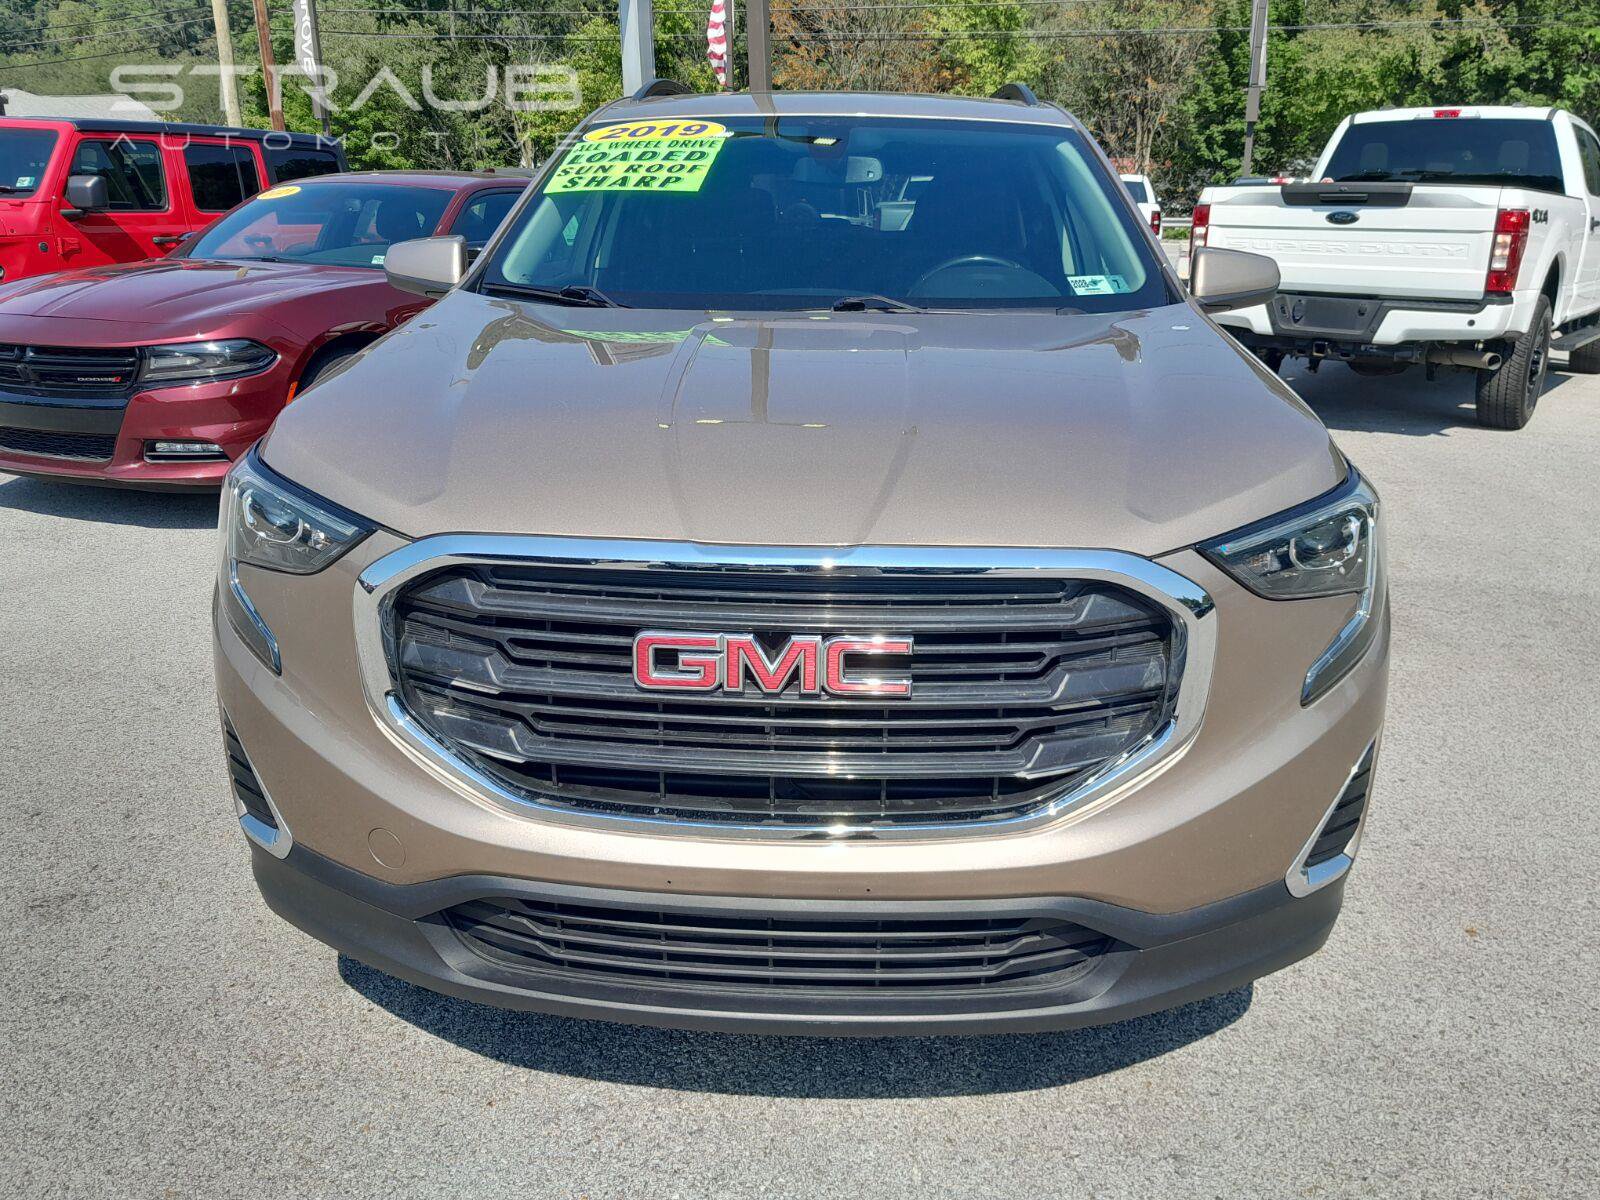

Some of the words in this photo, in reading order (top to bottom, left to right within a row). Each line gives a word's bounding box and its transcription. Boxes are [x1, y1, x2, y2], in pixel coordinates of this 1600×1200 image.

[600, 123, 709, 140] 2019
[576, 141, 603, 151] ALL
[608, 140, 662, 150] WHEEL
[667, 138, 720, 149] DRIVE
[567, 150, 709, 165] LOADED
[556, 164, 616, 177] SUN
[623, 163, 707, 174] ROOF
[562, 175, 682, 188] SHARP
[1224, 238, 1350, 254] SUPER
[1363, 243, 1466, 258] DUTY
[632, 628, 914, 700] GMC
